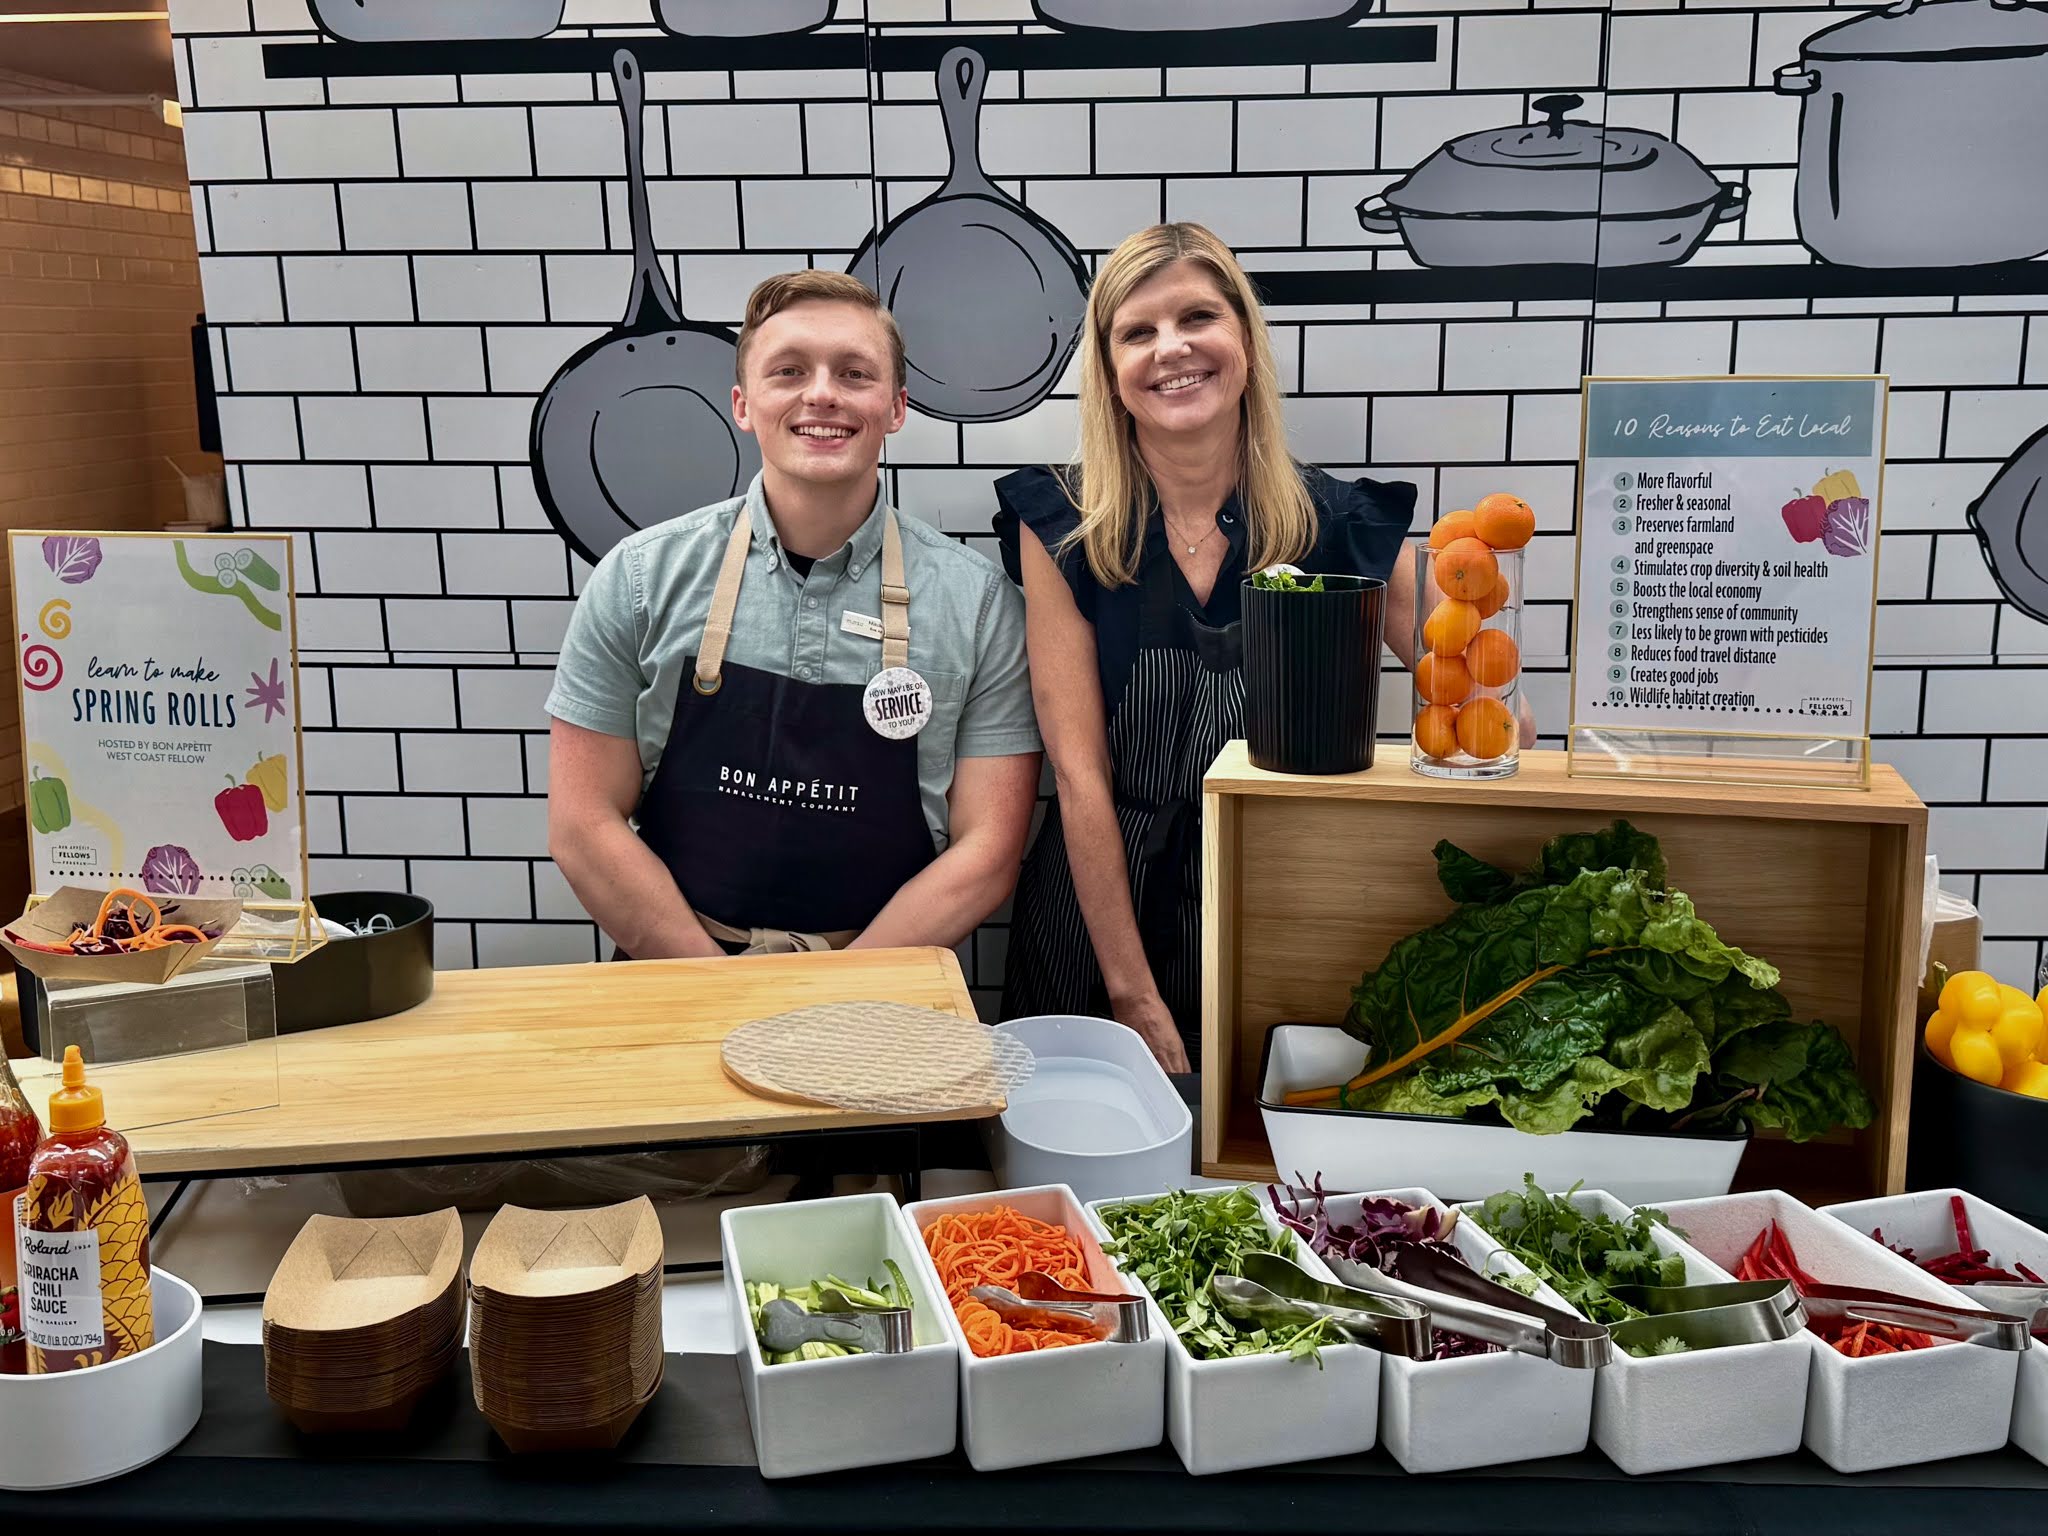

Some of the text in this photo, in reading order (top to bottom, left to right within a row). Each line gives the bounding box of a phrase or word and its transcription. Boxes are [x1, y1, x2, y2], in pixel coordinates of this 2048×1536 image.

[1614, 414, 1852, 439] 10 Reasons to Eat Local
[1620, 473, 1712, 490] 1 More flavorful
[1619, 495, 1731, 511] 2 Fresher & seasonal
[1618, 517, 1734, 533] 3 Preserves farmland
[1635, 538, 1714, 558] and greenspace
[1617, 560, 1828, 580] 4 Stimulates crop diversity & soil health
[1616, 582, 1762, 602] 5 Boosts the local economy
[1615, 602, 1798, 624] 6 Strengthens sense of community
[1615, 624, 1828, 646] 7 Less likely to be grown with pesticides
[1614, 646, 1776, 664] 8 Reduces food travel distance
[88, 656, 220, 682] learn to make
[1613, 667, 1719, 686] 9 Creates good jobs
[869, 689, 885, 698] HOW
[888, 686, 901, 695] MAY
[1610, 687, 1755, 707] 10 Wildlife habitat creation
[73, 688, 236, 728] SPRING ROLLS
[875, 692, 923, 721] SERVICE
[98, 739, 135, 748] HOSTED
[138, 741, 150, 749] BY
[152, 742, 174, 750] BON
[107, 752, 205, 763] WEST COAST FELLOW
[720, 766, 858, 800] BON APPÉTIT
[719, 786, 856, 812] MANAGEMENT COMPANY
[24, 1236, 70, 1255] Roland
[24, 1262, 79, 1281] SRIRACHA
[33, 1281, 62, 1297] CHILI
[31, 1297, 67, 1314] SAUCE
